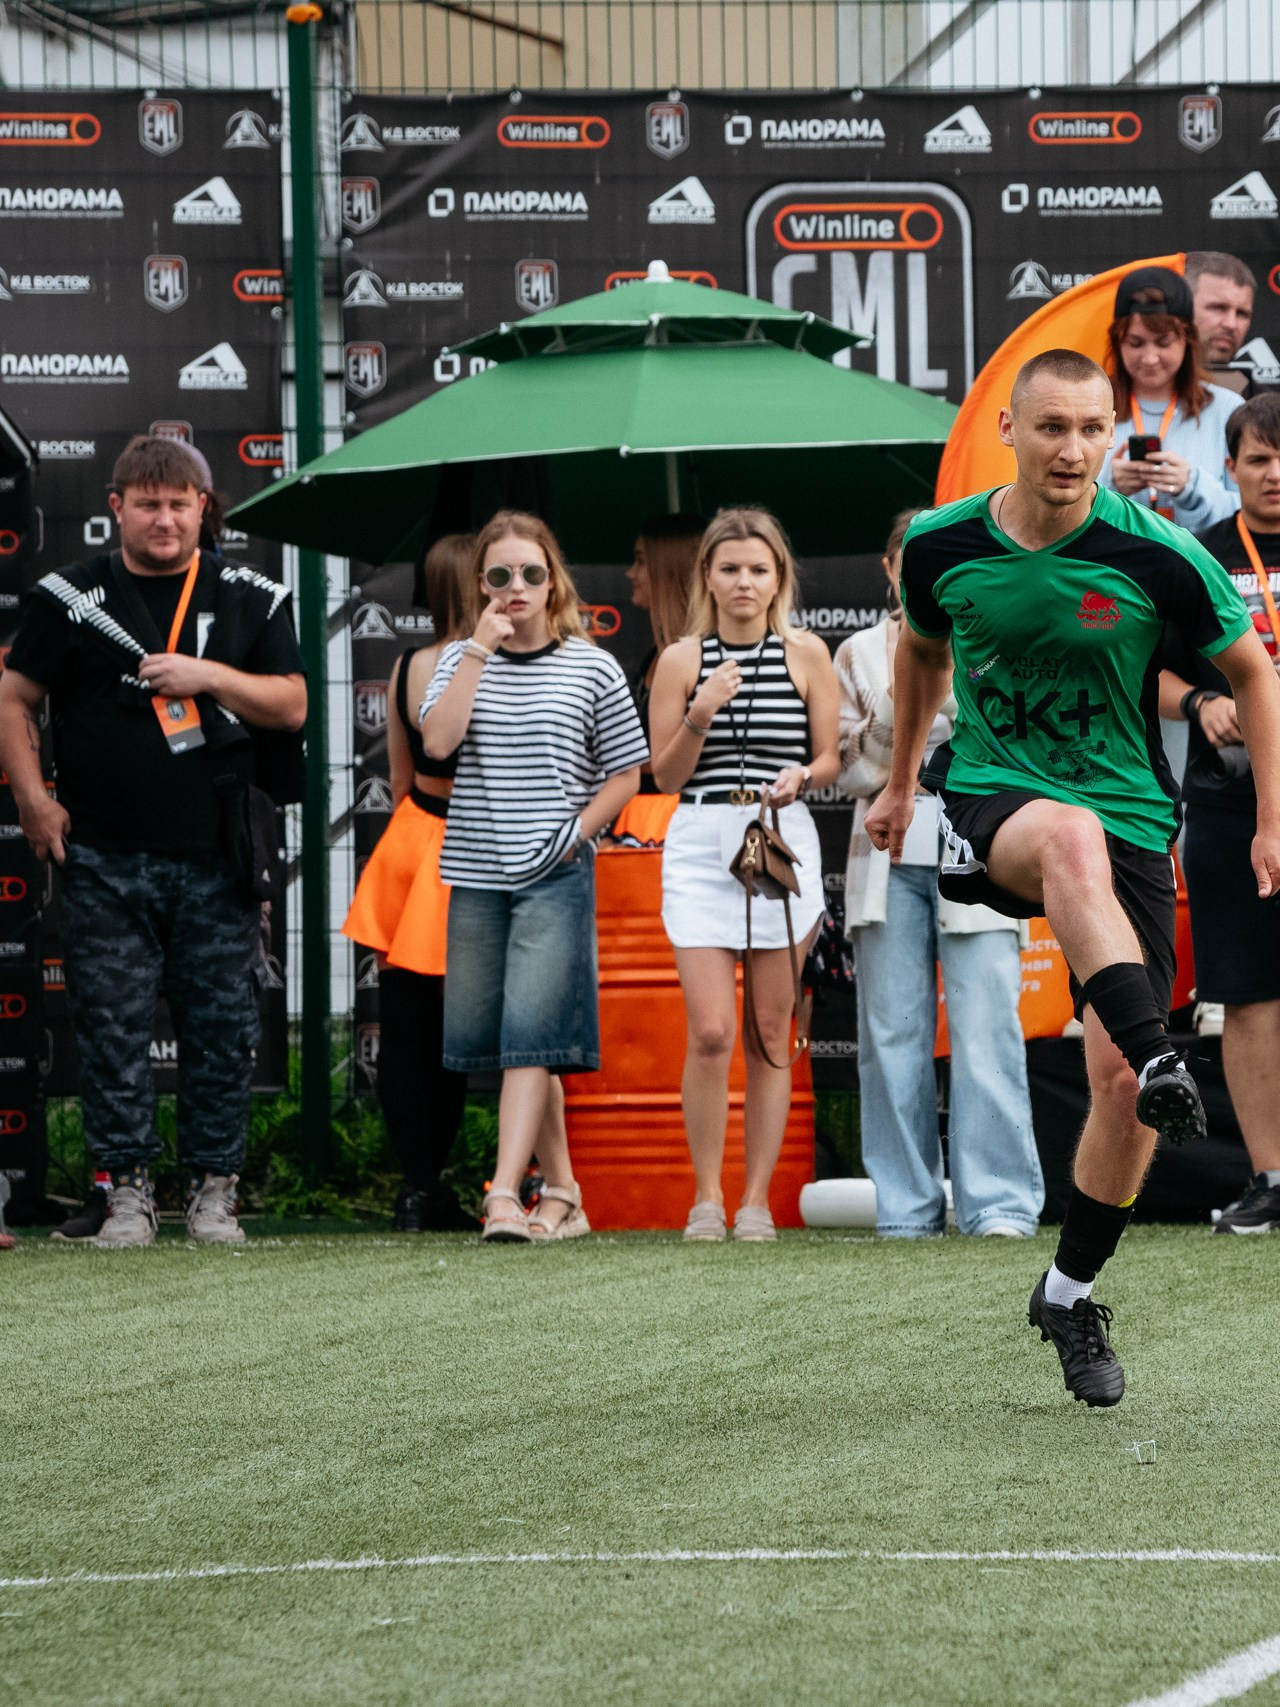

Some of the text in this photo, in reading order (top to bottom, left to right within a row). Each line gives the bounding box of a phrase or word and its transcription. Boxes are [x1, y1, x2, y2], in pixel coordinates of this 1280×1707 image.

[0, 121, 68, 139] Winline
[408, 126, 461, 141] ВОСТОК
[508, 122, 578, 142] Winline
[761, 119, 886, 140] ПАНОРАМА
[1038, 120, 1110, 137] Winline
[463, 191, 589, 212] ПАНОРАМА
[1037, 186, 1163, 207] ПАНОРАМА
[788, 215, 896, 240] Winline
[38, 274, 90, 290] ВОСТОК
[413, 282, 464, 296] ВОСТОК
[1, 353, 130, 376] ПАНОРАМА
[787, 609, 889, 630] АНОРАМА
[953, 613, 984, 621] DEMIX
[1010, 668, 1058, 681] AUTO
